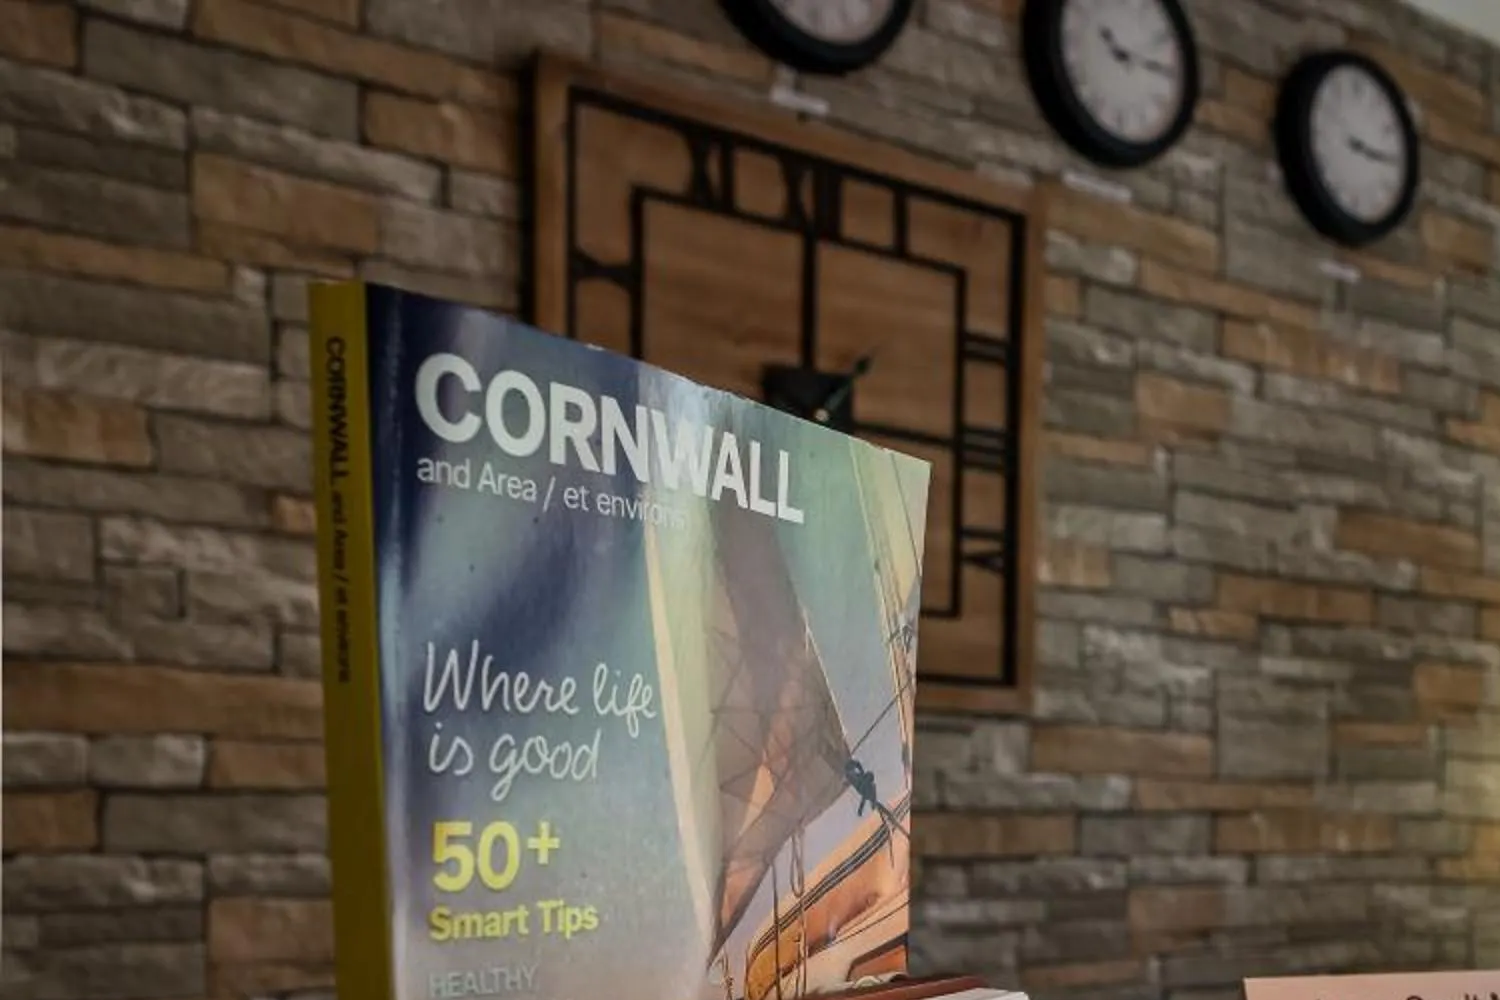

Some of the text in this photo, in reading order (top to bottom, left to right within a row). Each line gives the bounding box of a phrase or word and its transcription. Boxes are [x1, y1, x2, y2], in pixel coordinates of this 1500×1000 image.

[324, 336, 351, 488] CORNWALL
[414, 352, 805, 524] CORNWALL
[416, 457, 687, 529] and Area / et environs
[422, 639, 658, 739] Where life
[428, 721, 602, 801] is good
[431, 819, 560, 893] 50+
[429, 898, 599, 942] Smart Tips
[428, 961, 539, 998] HEALTHY
